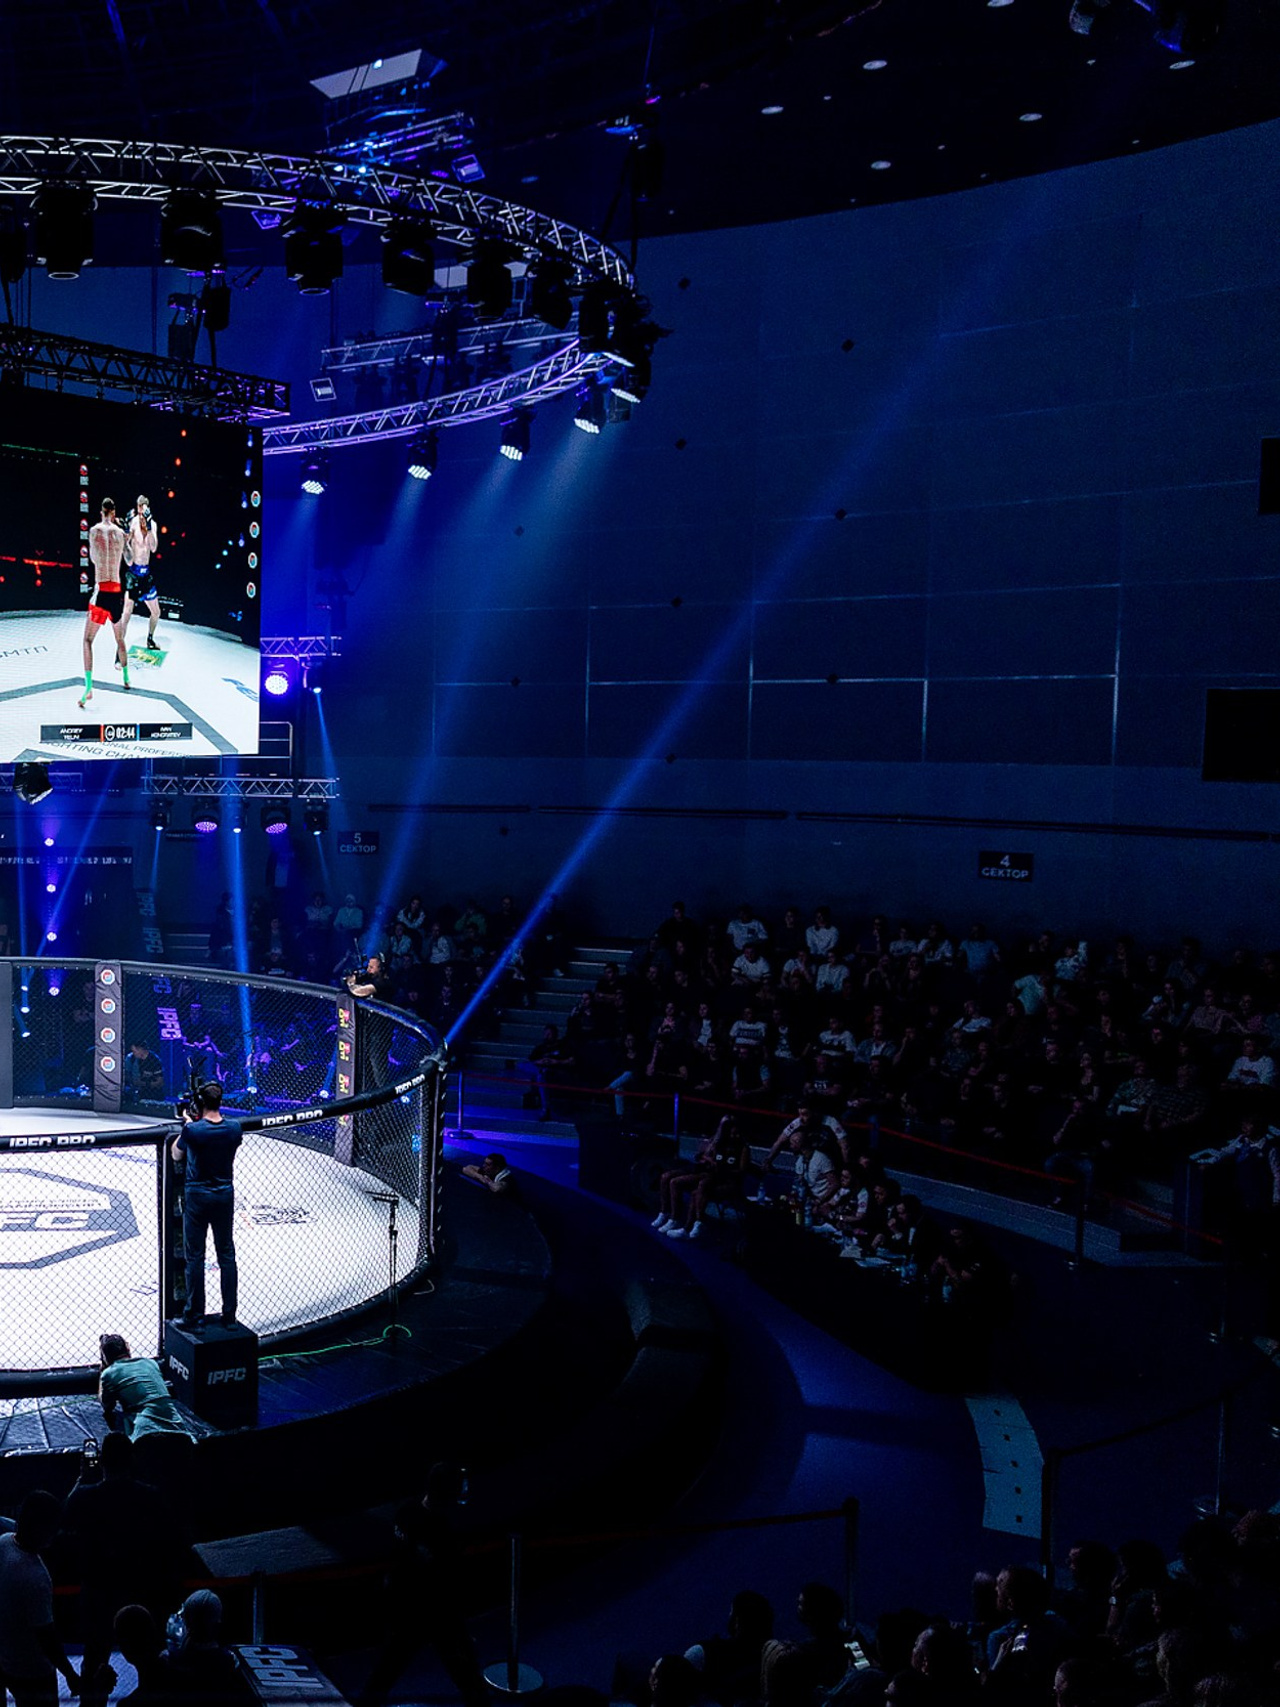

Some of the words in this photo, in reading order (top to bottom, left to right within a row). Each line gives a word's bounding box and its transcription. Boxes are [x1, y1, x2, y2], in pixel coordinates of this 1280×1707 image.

[353, 832, 362, 844] 5
[999, 854, 1011, 867] 4
[980, 867, 1029, 879] СЕКТОР
[168, 1355, 190, 1381] IPFC
[206, 1367, 247, 1385] IPFC
[238, 1646, 325, 1688] IPFC
